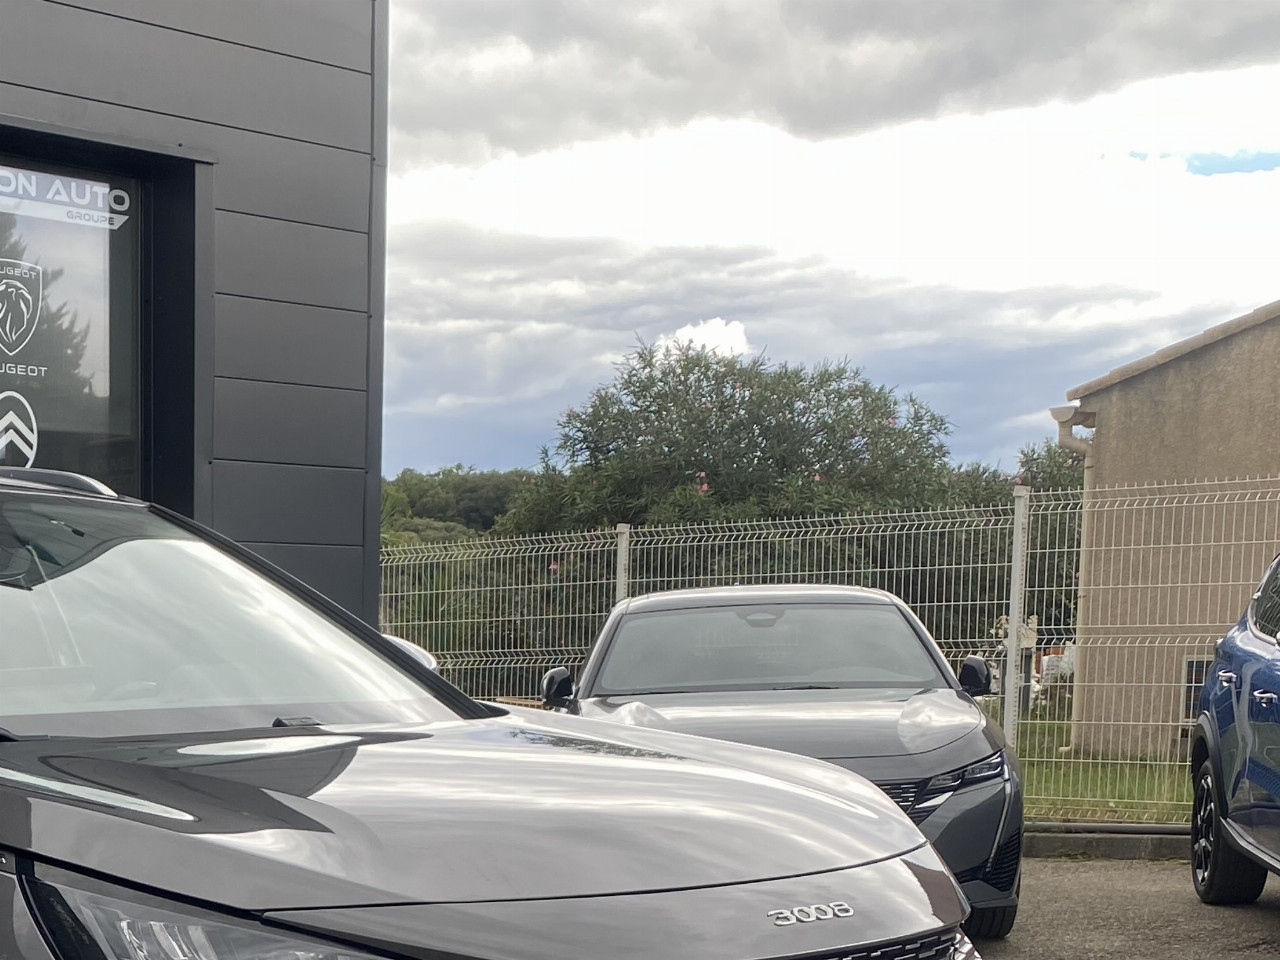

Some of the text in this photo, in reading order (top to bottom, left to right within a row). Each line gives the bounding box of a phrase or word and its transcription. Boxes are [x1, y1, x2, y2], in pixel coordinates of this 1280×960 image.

[46, 178, 131, 213] AUTO
[67, 210, 115, 226] GROUPE
[766, 900, 855, 927] 3008
